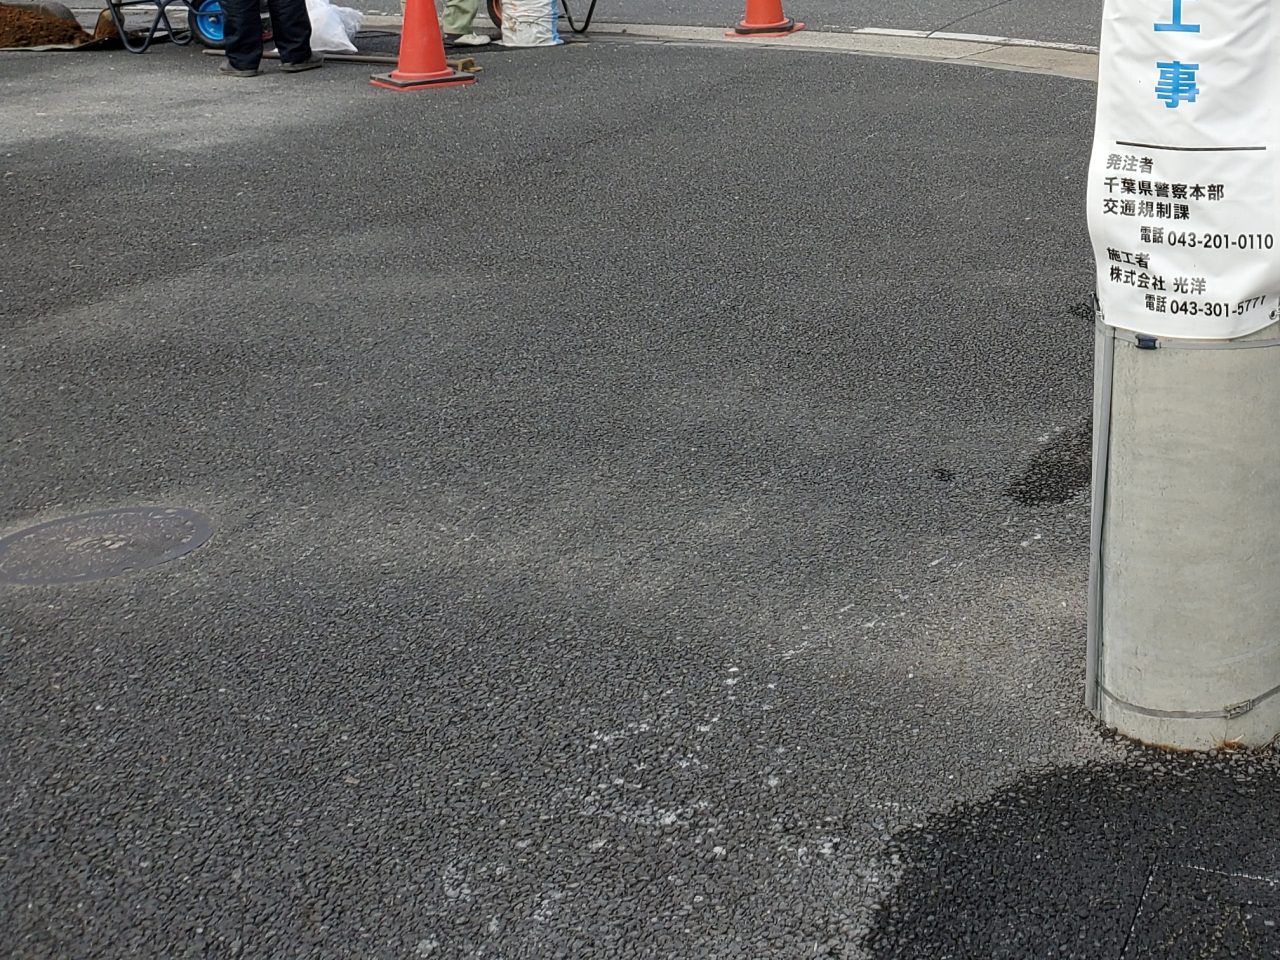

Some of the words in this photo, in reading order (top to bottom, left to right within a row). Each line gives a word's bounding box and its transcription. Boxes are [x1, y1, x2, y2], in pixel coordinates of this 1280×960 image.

[1106, 153, 1154, 175] 発注者
[1103, 176, 1225, 202] 千葉県警察本部
[1103, 197, 1191, 221] 交通規制課
[1140, 225, 1165, 245] 電話
[1167, 230, 1274, 250] 043-201-0110
[1107, 246, 1151, 270] 施工者
[1109, 264, 1167, 292] 株式会社
[1172, 276, 1207, 296] 光洋
[1144, 293, 1168, 314] 電話
